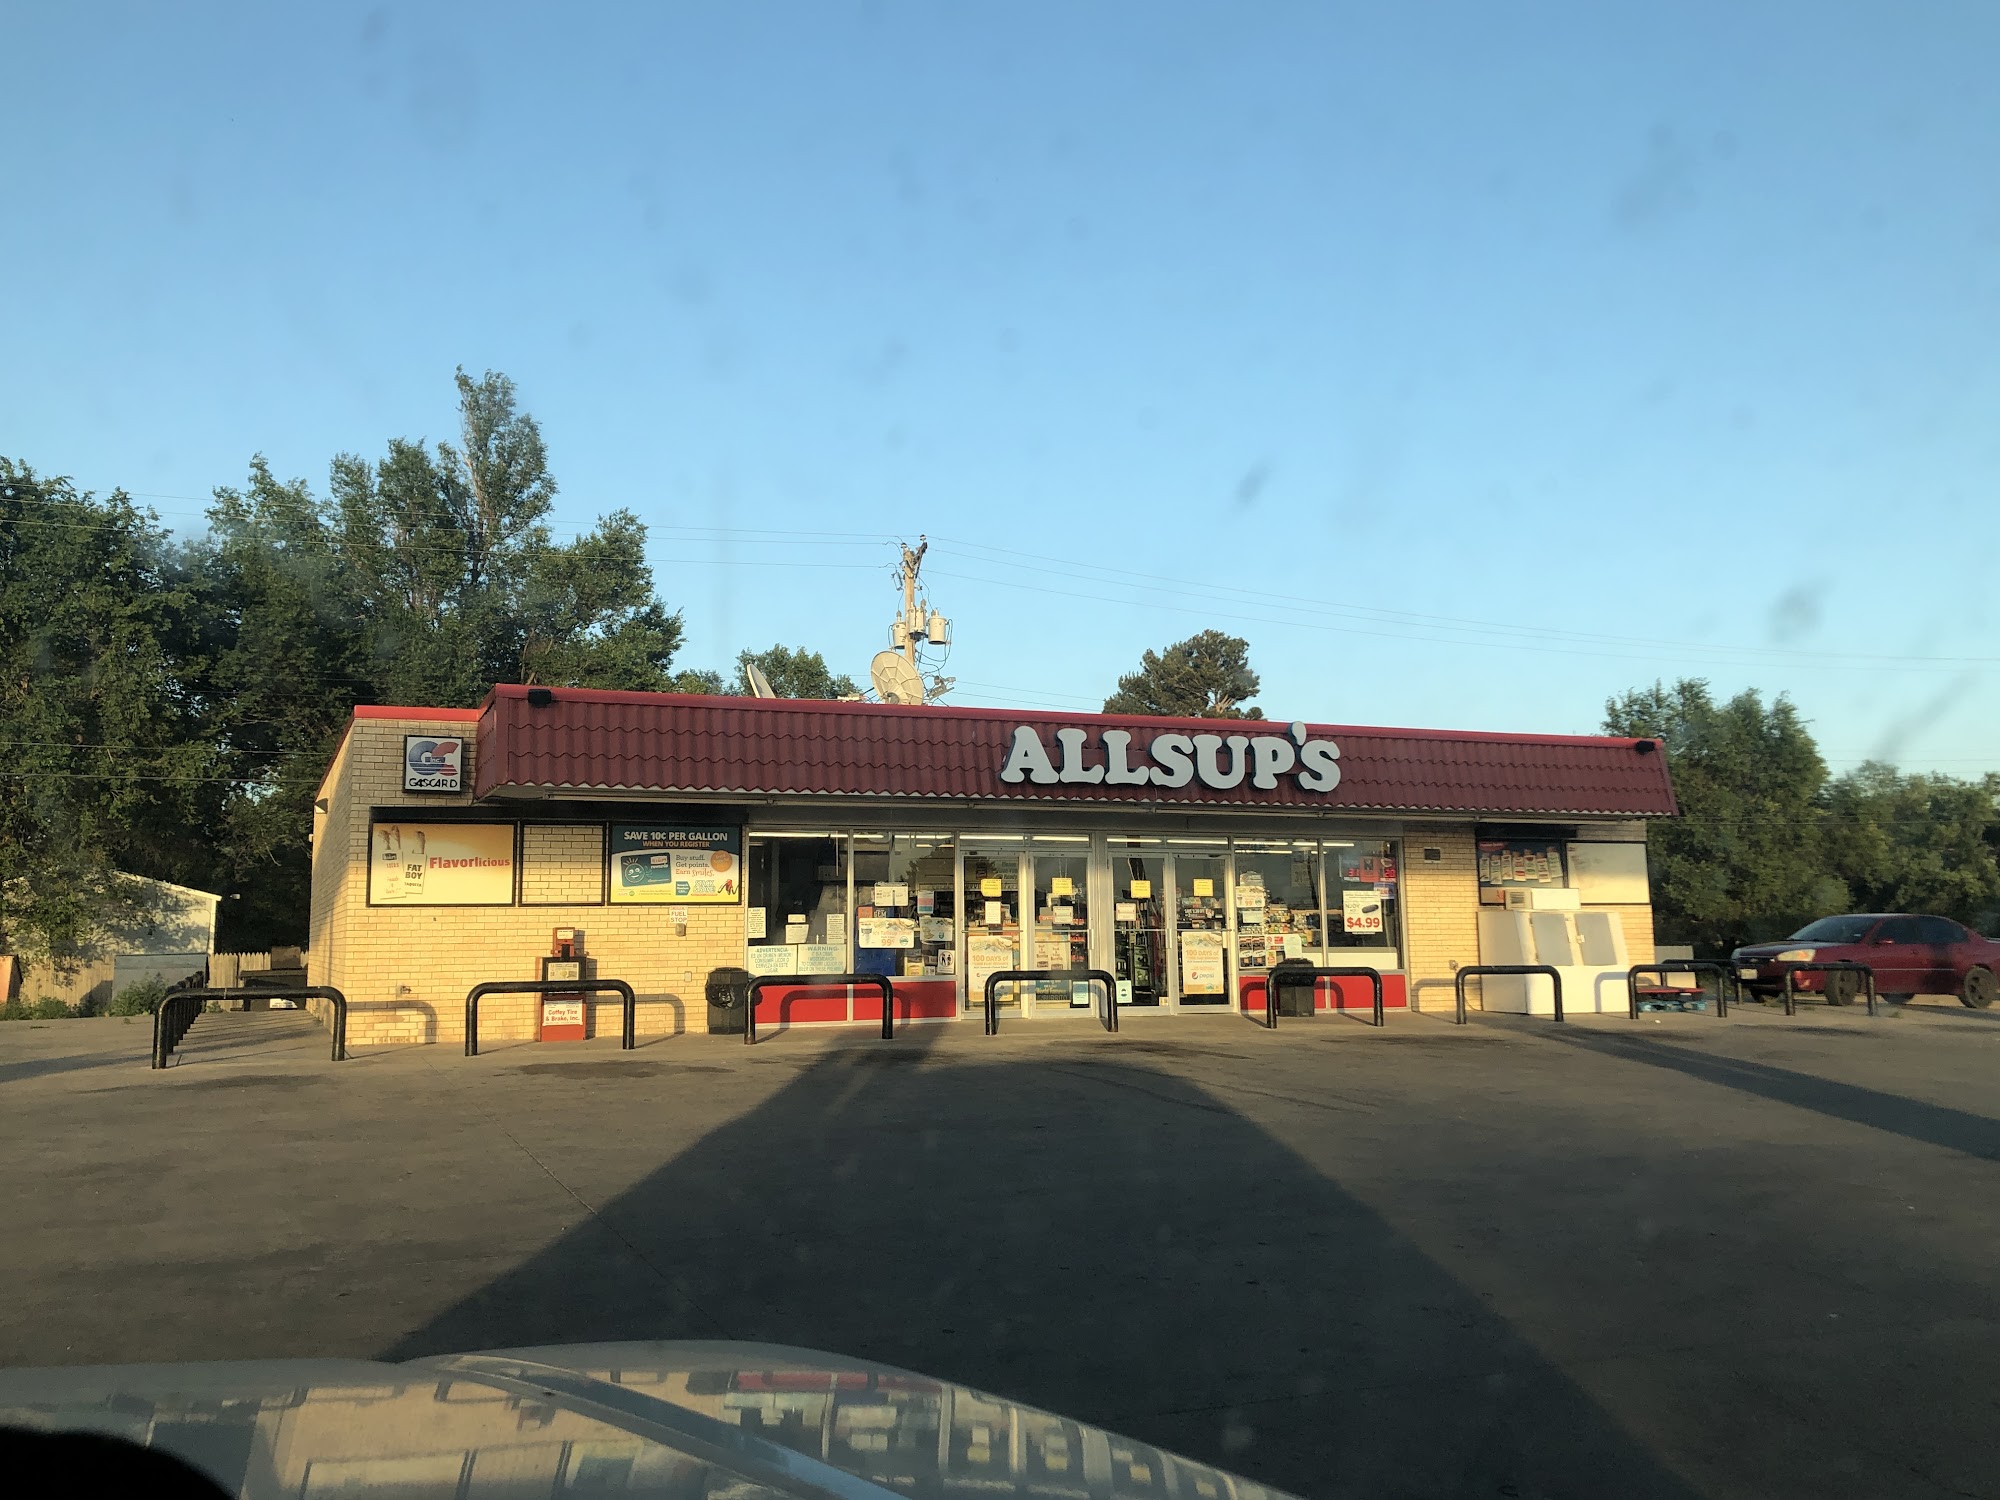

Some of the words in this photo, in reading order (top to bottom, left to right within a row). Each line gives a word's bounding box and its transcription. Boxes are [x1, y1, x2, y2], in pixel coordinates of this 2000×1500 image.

[1000, 721, 1341, 792] ALLSUP'S
[409, 778, 458, 787] GASCARD
[624, 832, 648, 840] SAVE
[650, 832, 666, 840] 10¢
[669, 832, 686, 840] PER
[688, 832, 728, 841] GALLON
[430, 856, 510, 868] Flavorlicious
[1346, 917, 1380, 928] $4.99
